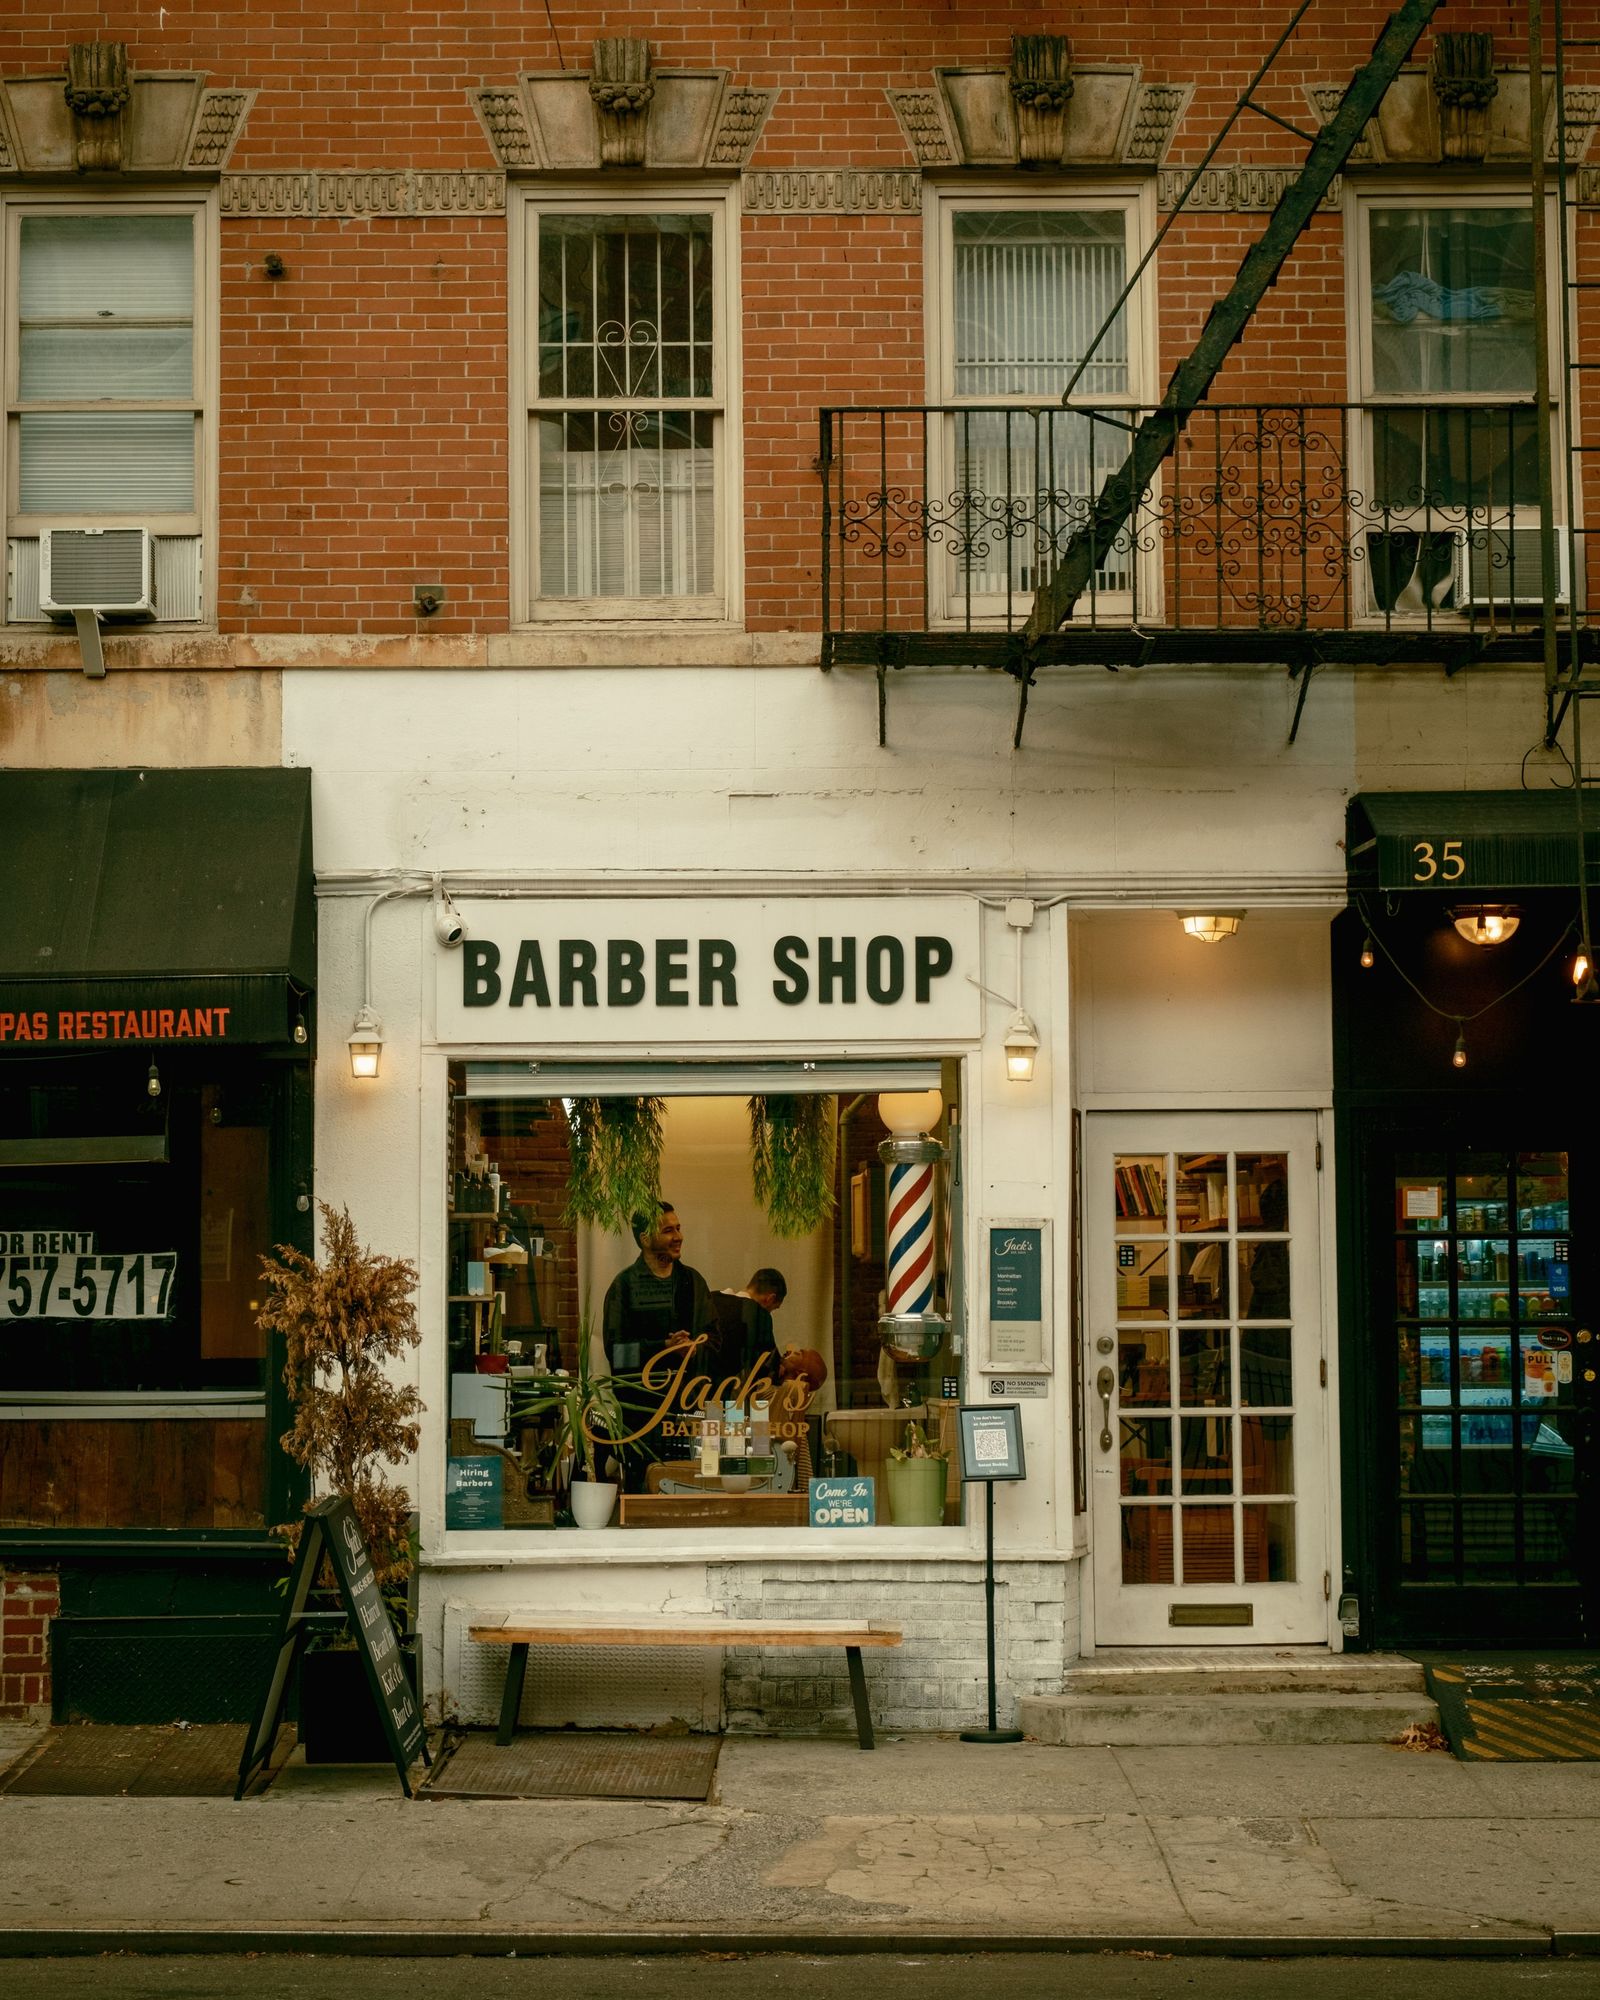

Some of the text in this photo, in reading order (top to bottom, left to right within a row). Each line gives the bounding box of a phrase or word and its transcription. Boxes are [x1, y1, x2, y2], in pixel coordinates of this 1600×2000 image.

[1413, 841, 1466, 881] 35
[463, 934, 954, 1008] BARBER SHOP
[0, 1007, 230, 1041] PAS RESTAURANT
[32, 1232, 92, 1254] RENT
[994, 1236, 1033, 1256] Jack's
[0, 1255, 176, 1317] 57-5717
[1527, 1355, 1556, 1364] PULL
[661, 1421, 811, 1438] BARBER HOP
[459, 1468, 489, 1478] Hiring
[455, 1479, 493, 1487] Barbers
[815, 1482, 868, 1500] Come In
[828, 1499, 853, 1507] WE'RE
[815, 1507, 869, 1524] OPEN
